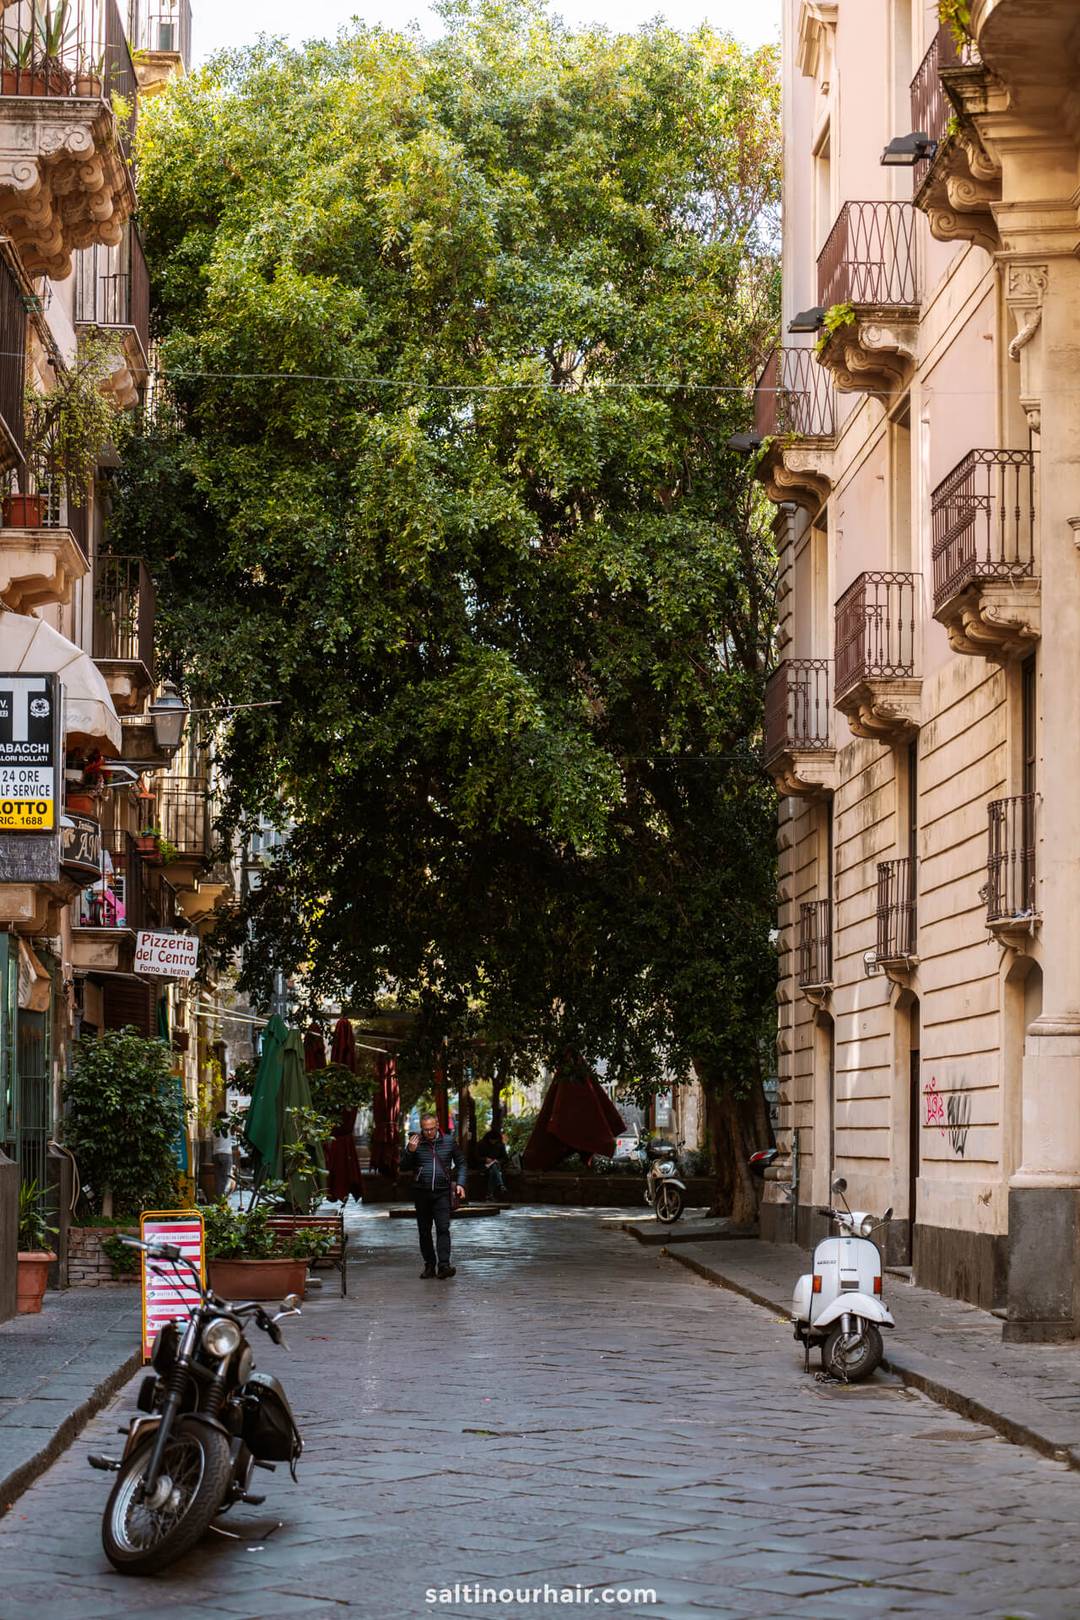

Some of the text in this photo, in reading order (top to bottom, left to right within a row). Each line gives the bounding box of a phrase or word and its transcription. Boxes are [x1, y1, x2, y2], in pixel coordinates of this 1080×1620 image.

[0, 677, 46, 742] T
[0, 743, 50, 753] ABACCHI
[2, 770, 39, 782] 24 ORE
[13, 784, 50, 797] SERVICE
[20, 816, 43, 825] 1688
[141, 933, 194, 951] Pizzeria
[136, 948, 196, 966] del Centro
[140, 963, 160, 973] Forno
[170, 967, 190, 976] legna
